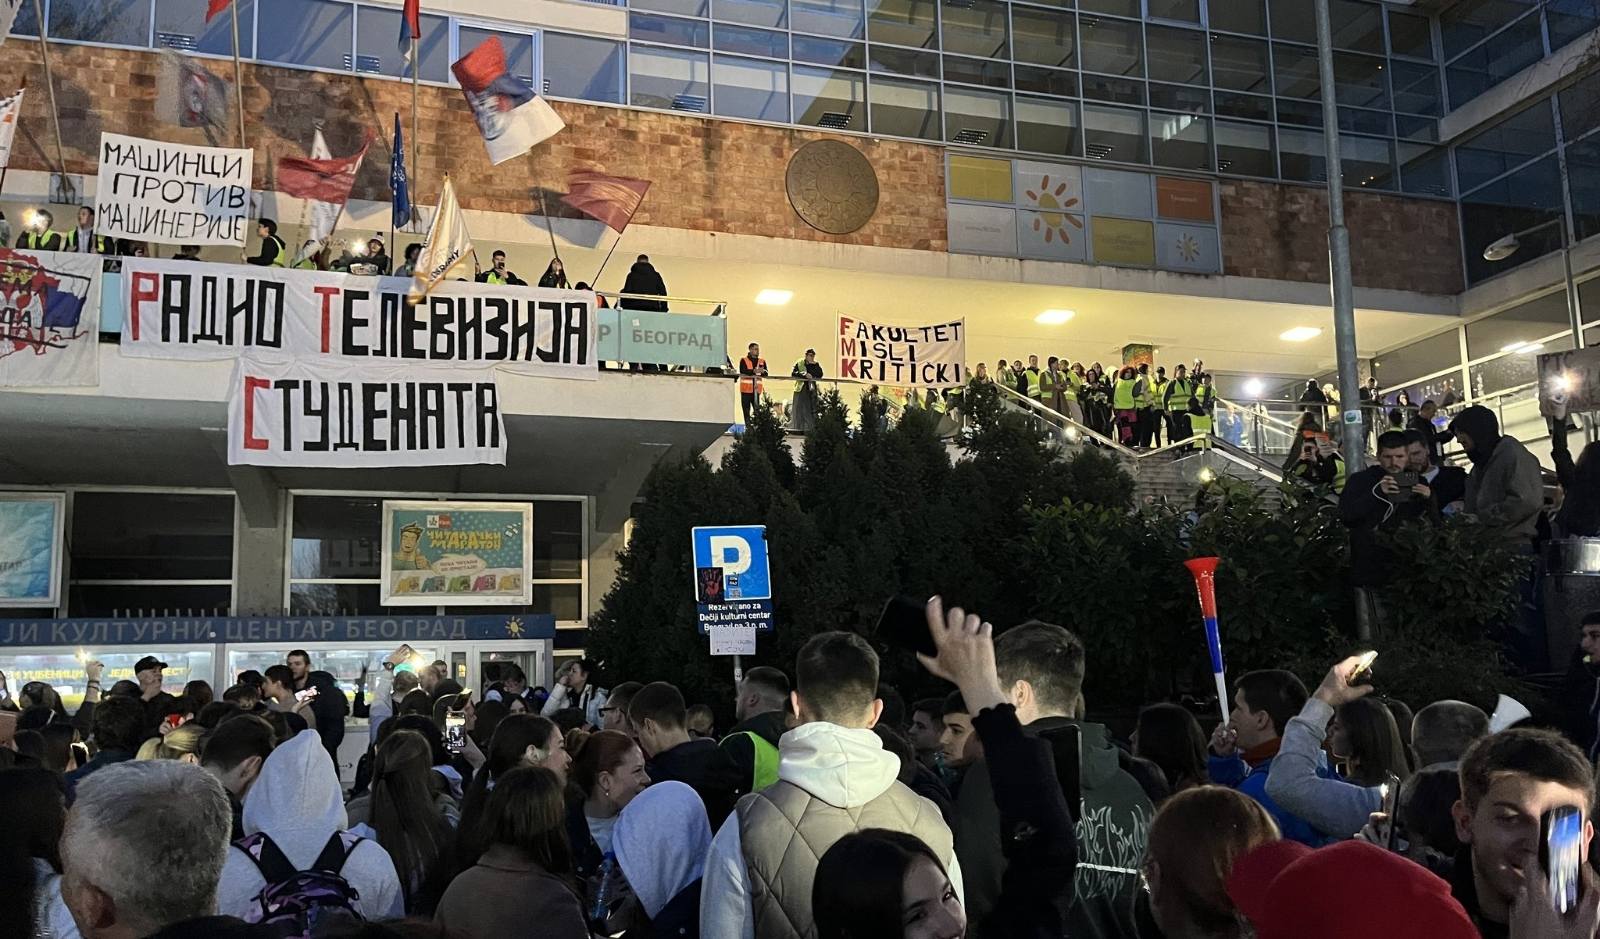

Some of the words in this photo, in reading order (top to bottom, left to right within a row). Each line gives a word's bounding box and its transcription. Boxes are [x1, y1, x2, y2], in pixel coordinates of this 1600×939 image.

[104, 141, 243, 179] МАШИНЦИ
[112, 172, 246, 208] ПРОТИВ
[97, 203, 247, 242] МАШИНЕРИЈЕ
[132, 272, 285, 348] РАДИО
[314, 286, 588, 365] ТЕЛЕВИЗИЈА
[840, 317, 962, 343] FAKULTET
[632, 328, 713, 351] БЕОГРАД
[841, 338, 917, 362] MISLI
[841, 359, 961, 384] KRITIČKI
[244, 376, 500, 452] СТУДЕНАТА
[709, 535, 752, 591] P
[51, 620, 210, 642] КУЛТУРНИ
[226, 620, 335, 641] ЦЕНТАР
[346, 618, 467, 639] БЕОГРАД
[720, 612, 747, 620] kulturni
